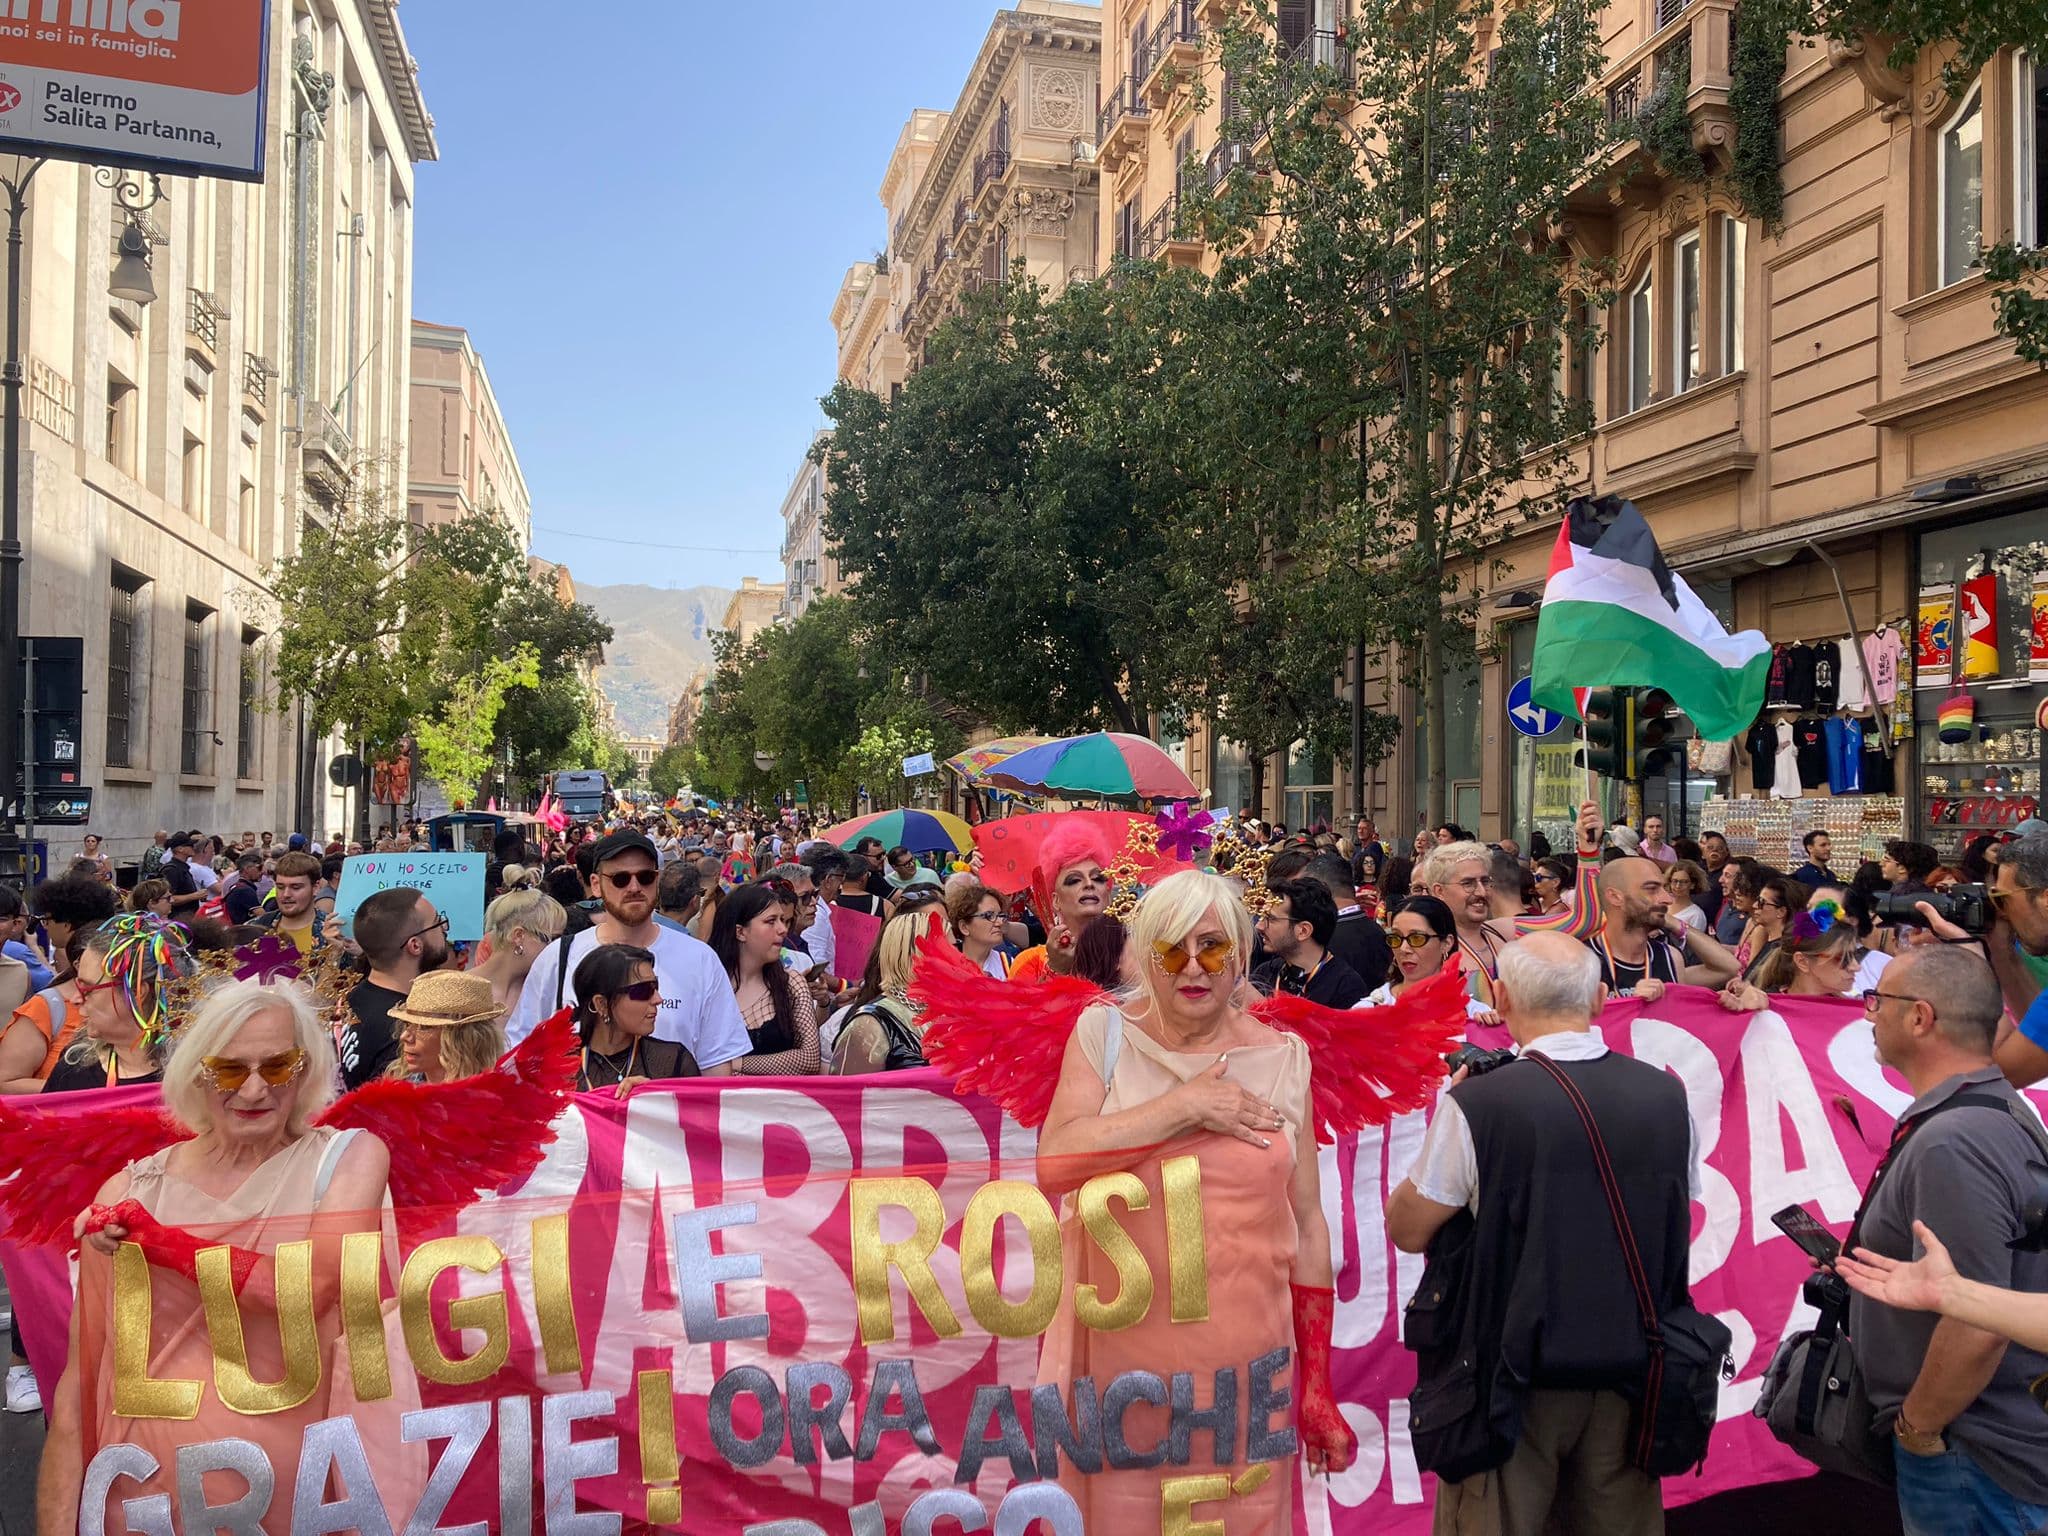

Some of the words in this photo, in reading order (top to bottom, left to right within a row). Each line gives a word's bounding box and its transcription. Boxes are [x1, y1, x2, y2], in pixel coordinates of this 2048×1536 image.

[0, 24, 29, 38] noi
[36, 28, 61, 42] sei
[68, 30, 85, 46] in
[91, 33, 176, 59] famiglia.
[45, 81, 137, 111] Palermo
[43, 104, 107, 130] Salita
[114, 113, 222, 149] Partanna,
[354, 862, 386, 875] NON
[399, 863, 414, 875] HO
[396, 880, 432, 889] ESSERE
[112, 1213, 582, 1420] LUIGI
[673, 1201, 770, 1344] E
[850, 1155, 1209, 1346] ROSI
[707, 1359, 943, 1469] ORA
[955, 1347, 1298, 1486] ANCHE
